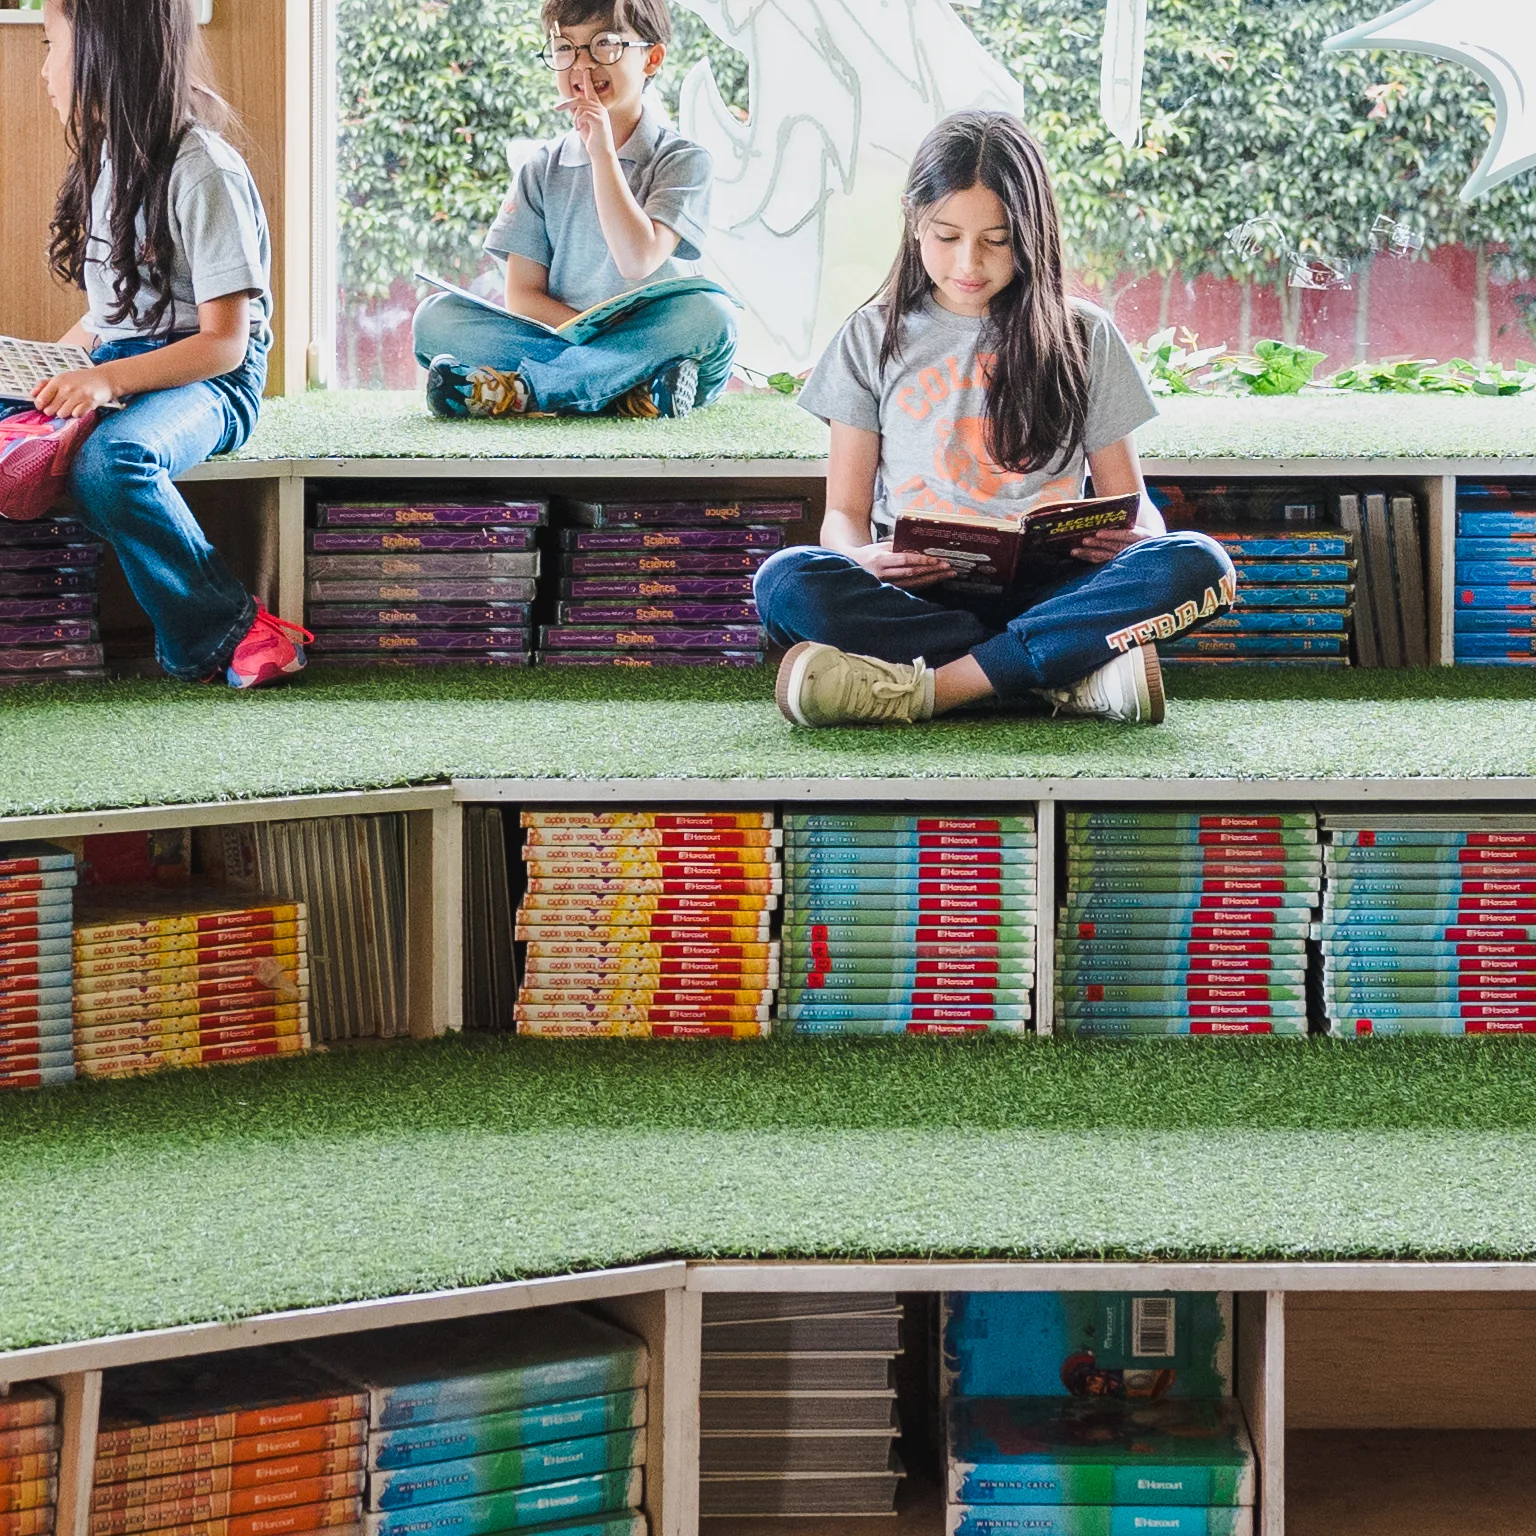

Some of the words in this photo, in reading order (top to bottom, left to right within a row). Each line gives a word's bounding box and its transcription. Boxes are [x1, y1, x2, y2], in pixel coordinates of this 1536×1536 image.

[683, 817, 714, 825] Harcourt
[946, 820, 976, 829] Harcourt
[691, 833, 721, 842] Harcourt
[948, 852, 978, 861] Harcourt
[269, 1413, 303, 1424] Harcourt
[979, 1480, 1022, 1488] WINNING
[1027, 1480, 1056, 1489] CATCH
[1147, 1480, 1183, 1490] Harcourt
[1144, 1518, 1180, 1528] Harcourt
